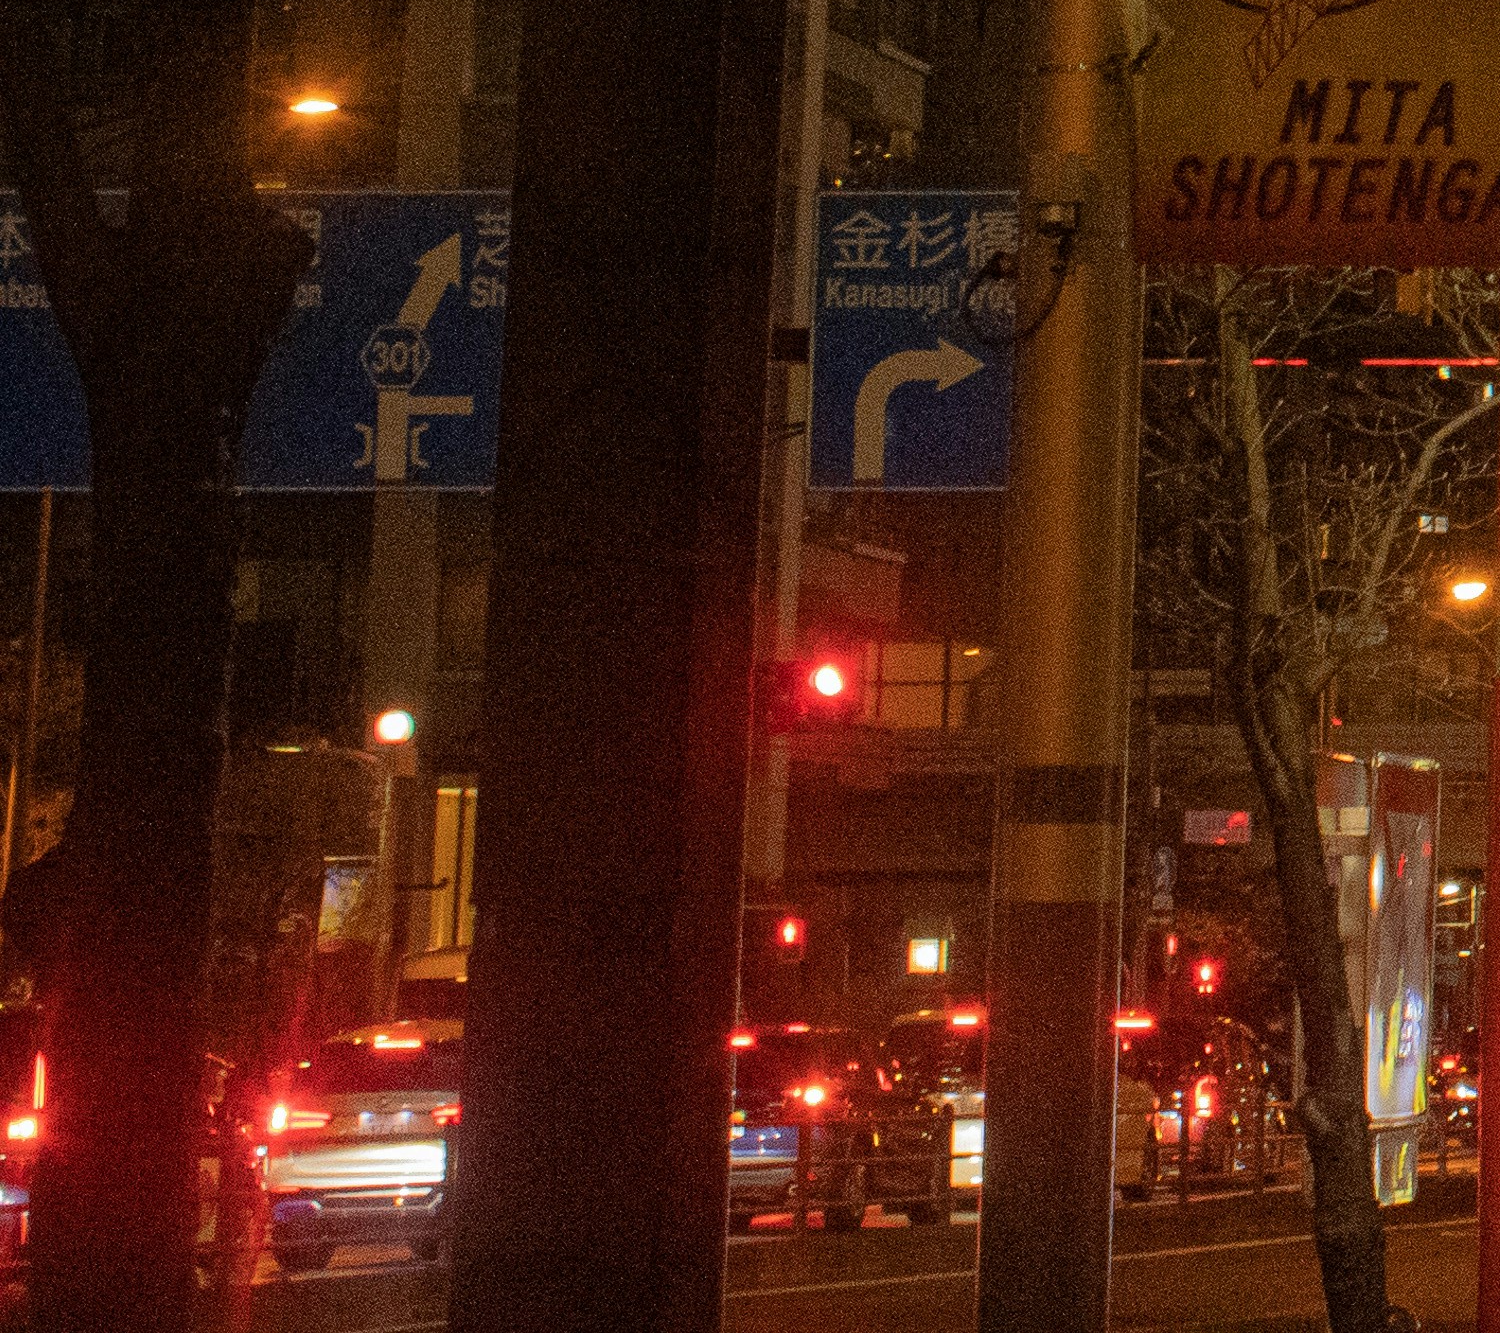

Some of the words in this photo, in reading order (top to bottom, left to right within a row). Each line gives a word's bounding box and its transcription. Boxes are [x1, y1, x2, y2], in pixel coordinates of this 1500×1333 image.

[1279, 79, 1457, 146] MITA
[831, 208, 1019, 270] 金杉橋
[824, 276, 950, 315] Kanasugi
[369, 341, 423, 373] 301
